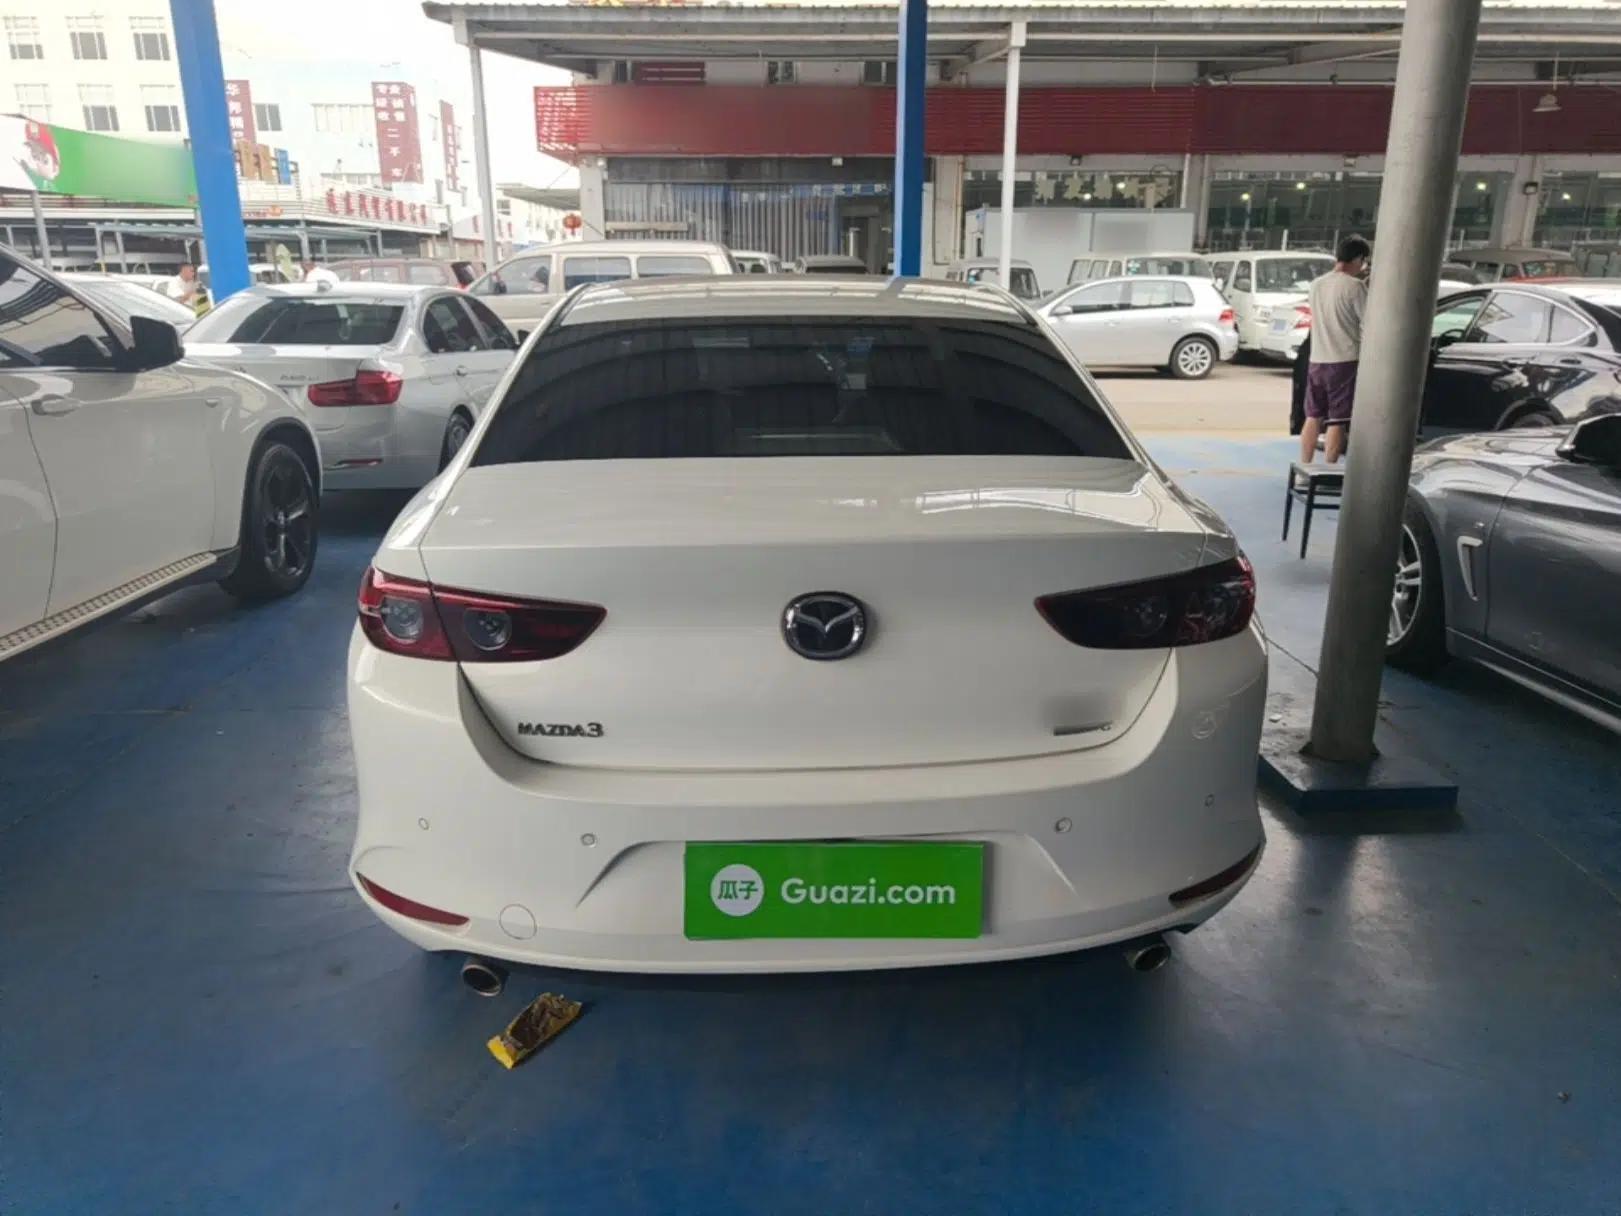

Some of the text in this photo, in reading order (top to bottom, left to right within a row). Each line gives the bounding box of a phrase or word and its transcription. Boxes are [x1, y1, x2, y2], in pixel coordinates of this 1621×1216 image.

[517, 722, 604, 738] MAZDA3
[717, 880, 759, 901] 瓜子
[780, 878, 956, 905] Guazi.com
